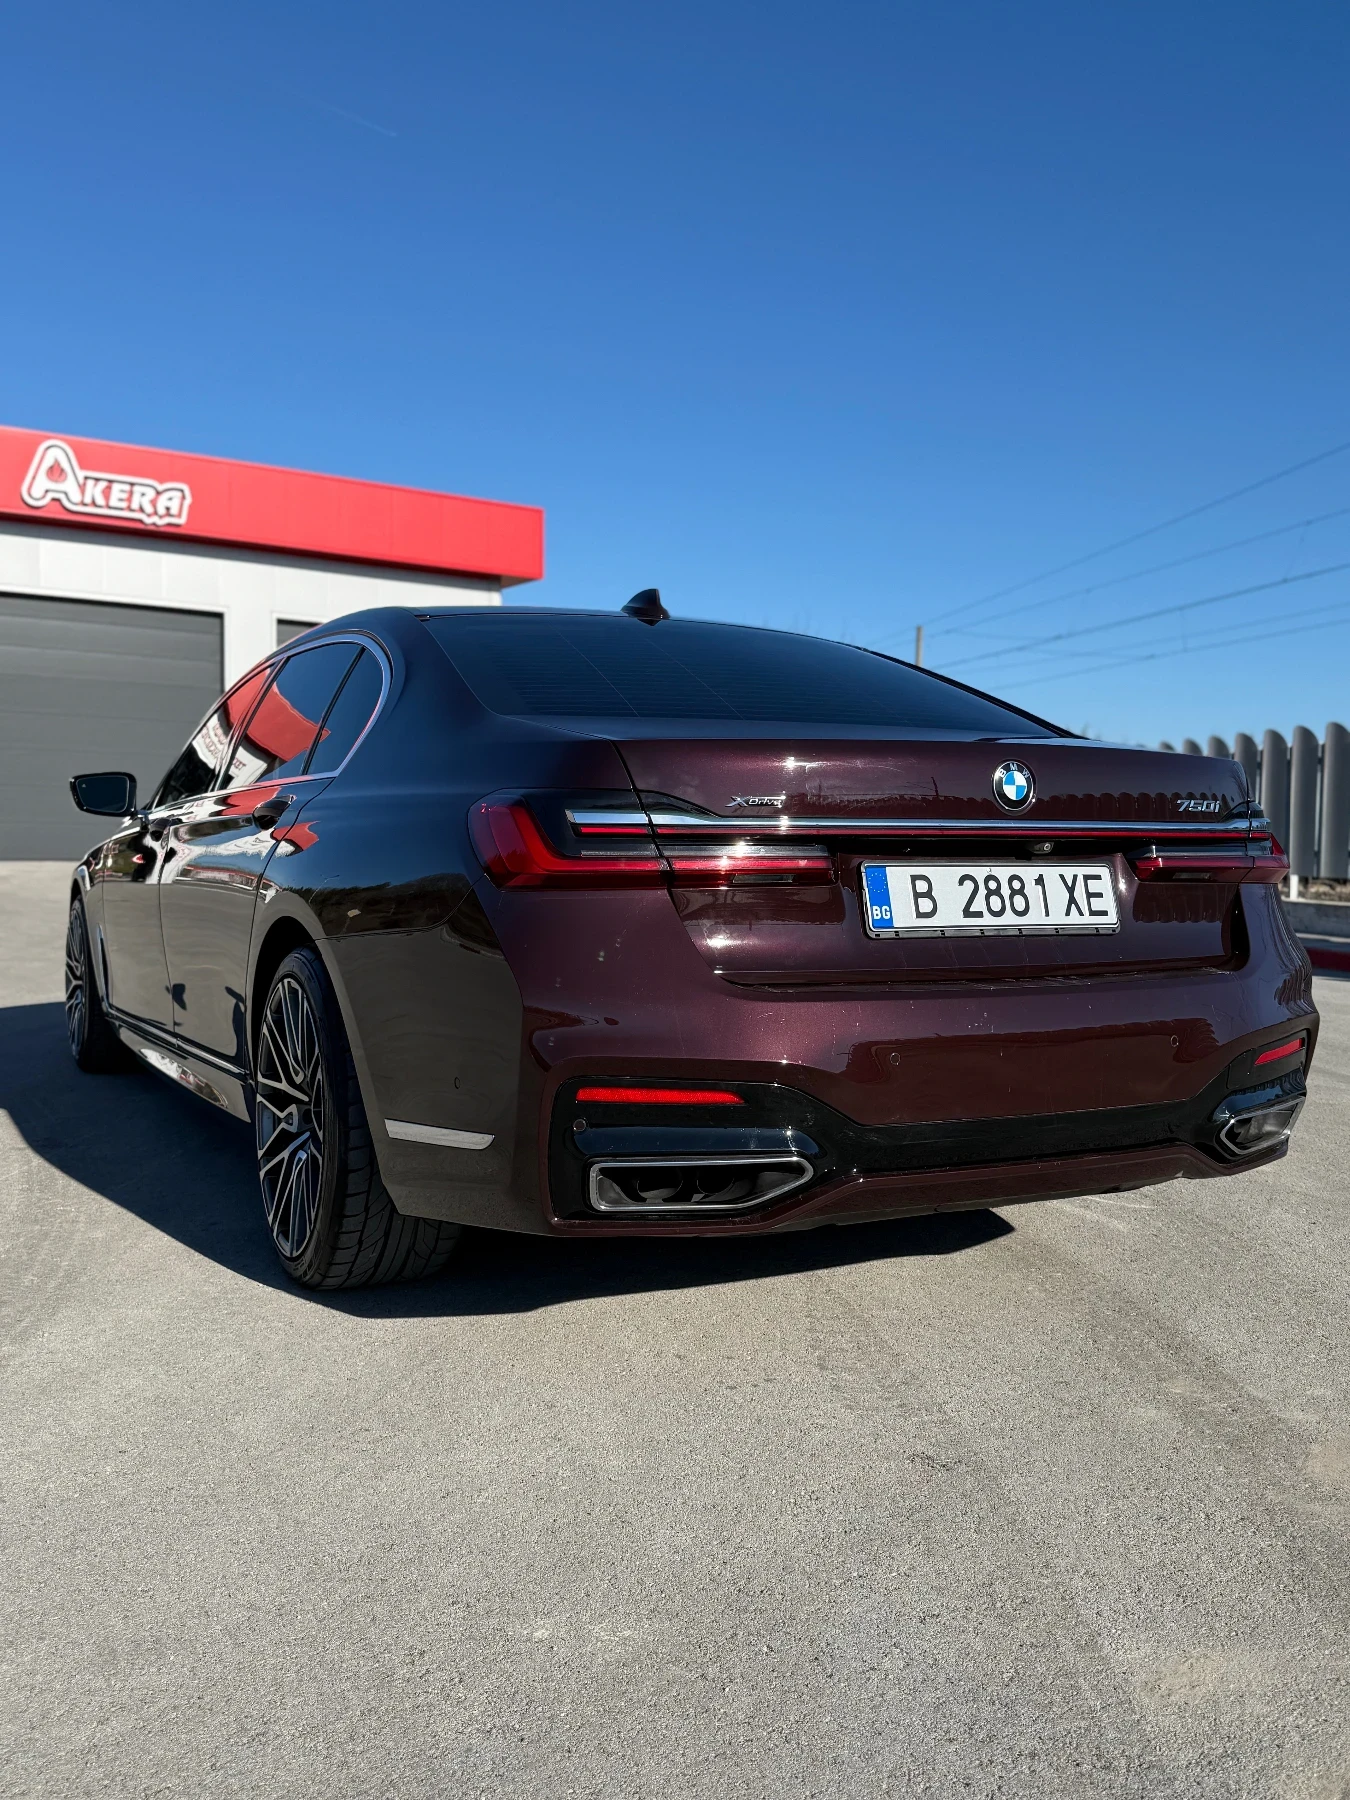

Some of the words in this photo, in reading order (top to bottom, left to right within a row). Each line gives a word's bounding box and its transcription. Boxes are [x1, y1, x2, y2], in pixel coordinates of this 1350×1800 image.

[999, 762, 1031, 779] BMW
[1176, 799, 1220, 813] 750i
[909, 874, 938, 919] B
[957, 873, 1050, 919] 2881
[1058, 873, 1109, 917] XE
[872, 905, 891, 920] BG
